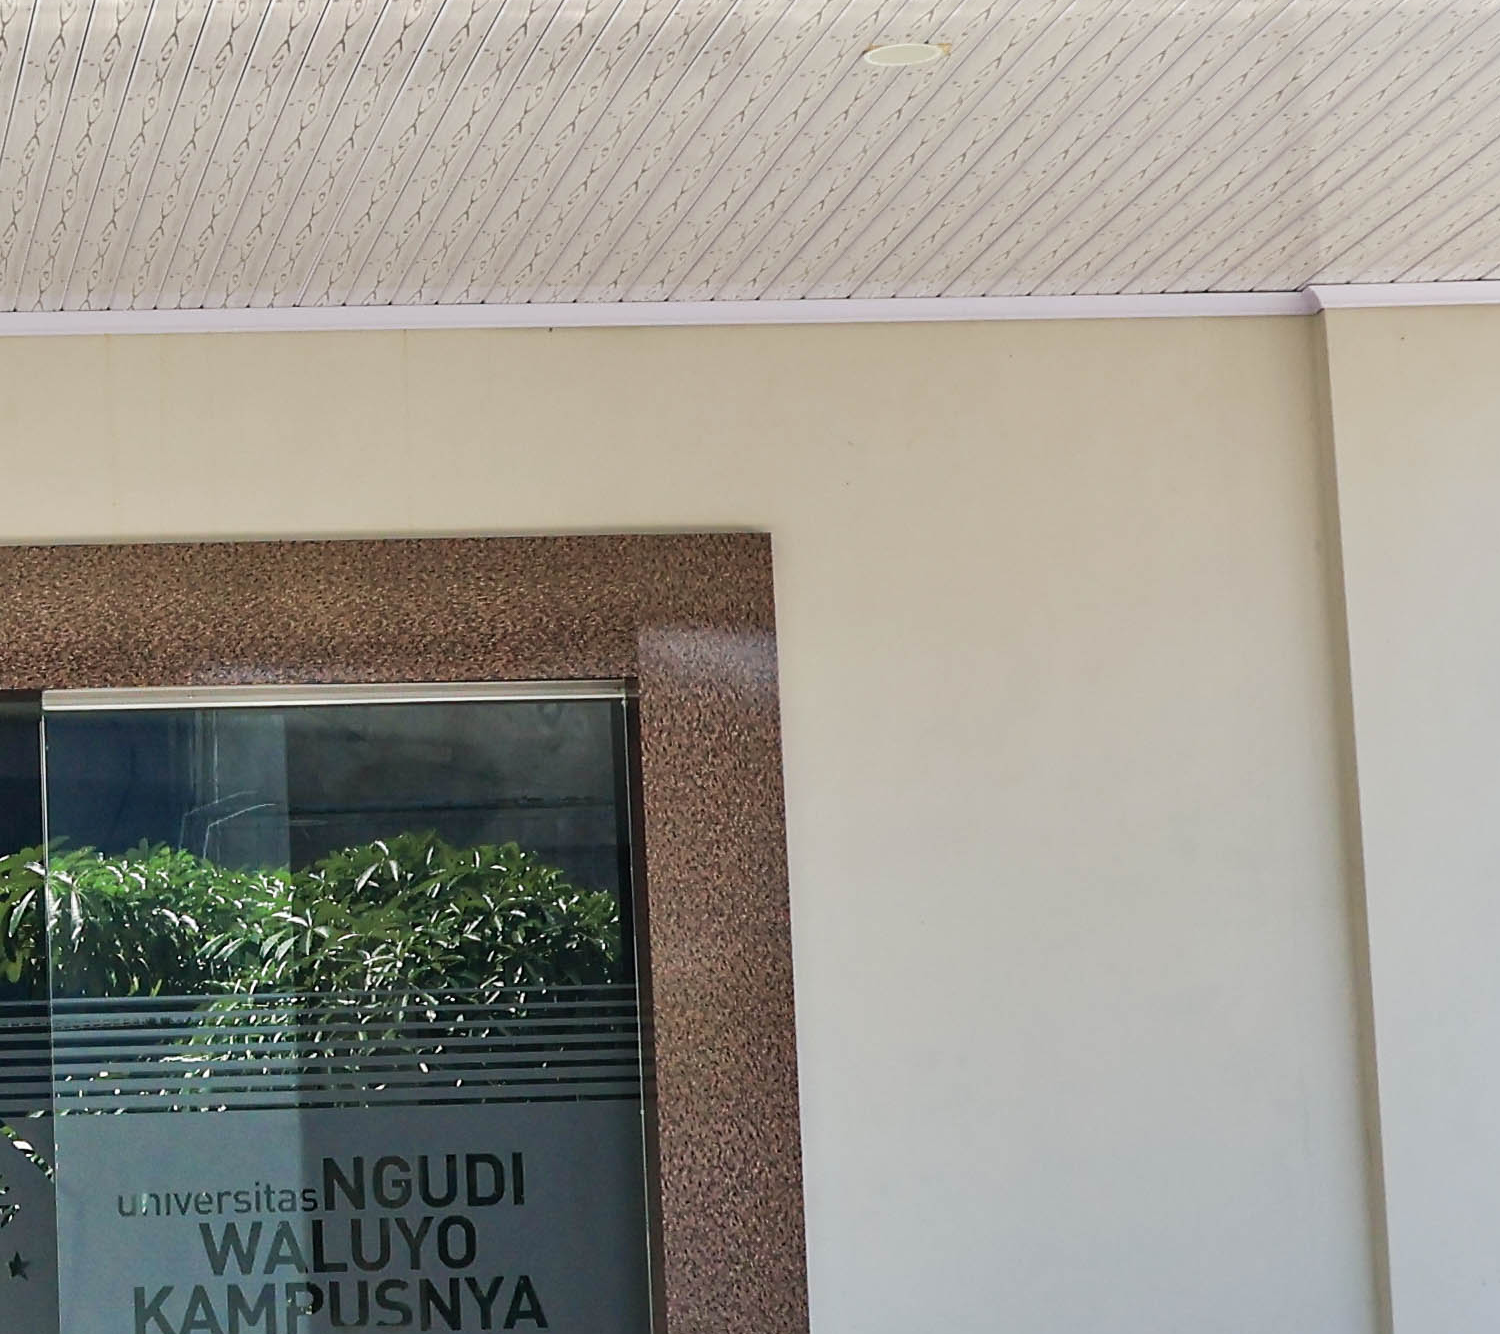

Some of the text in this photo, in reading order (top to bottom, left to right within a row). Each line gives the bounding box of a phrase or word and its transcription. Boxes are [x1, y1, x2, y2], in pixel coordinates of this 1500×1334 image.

[117, 1152, 524, 1216] universitas NGUDI
[198, 1215, 477, 1276] WALUYO
